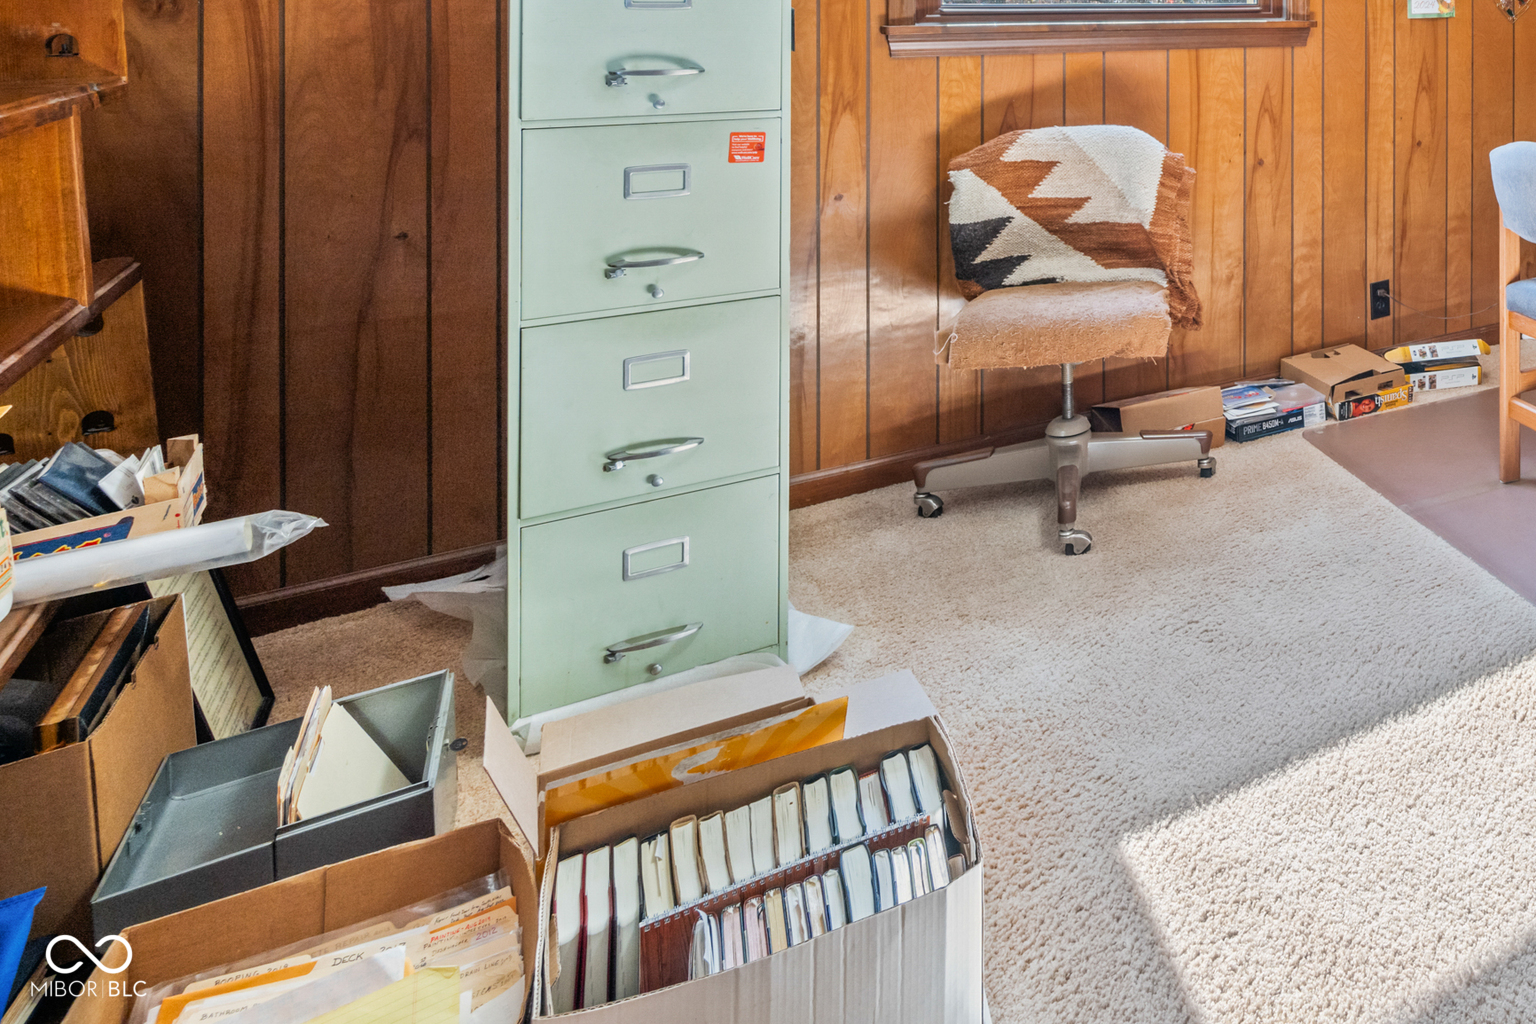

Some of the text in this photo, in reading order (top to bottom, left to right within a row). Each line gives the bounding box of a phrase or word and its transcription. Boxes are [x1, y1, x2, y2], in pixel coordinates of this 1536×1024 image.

[1374, 387, 1408, 407] Spanish
[1243, 422, 1262, 435] PRIME
[1288, 415, 1303, 424] ASUS
[475, 926, 498, 941] 2012
[331, 952, 364, 967] DECK
[200, 1006, 248, 1022] BATHROOM
